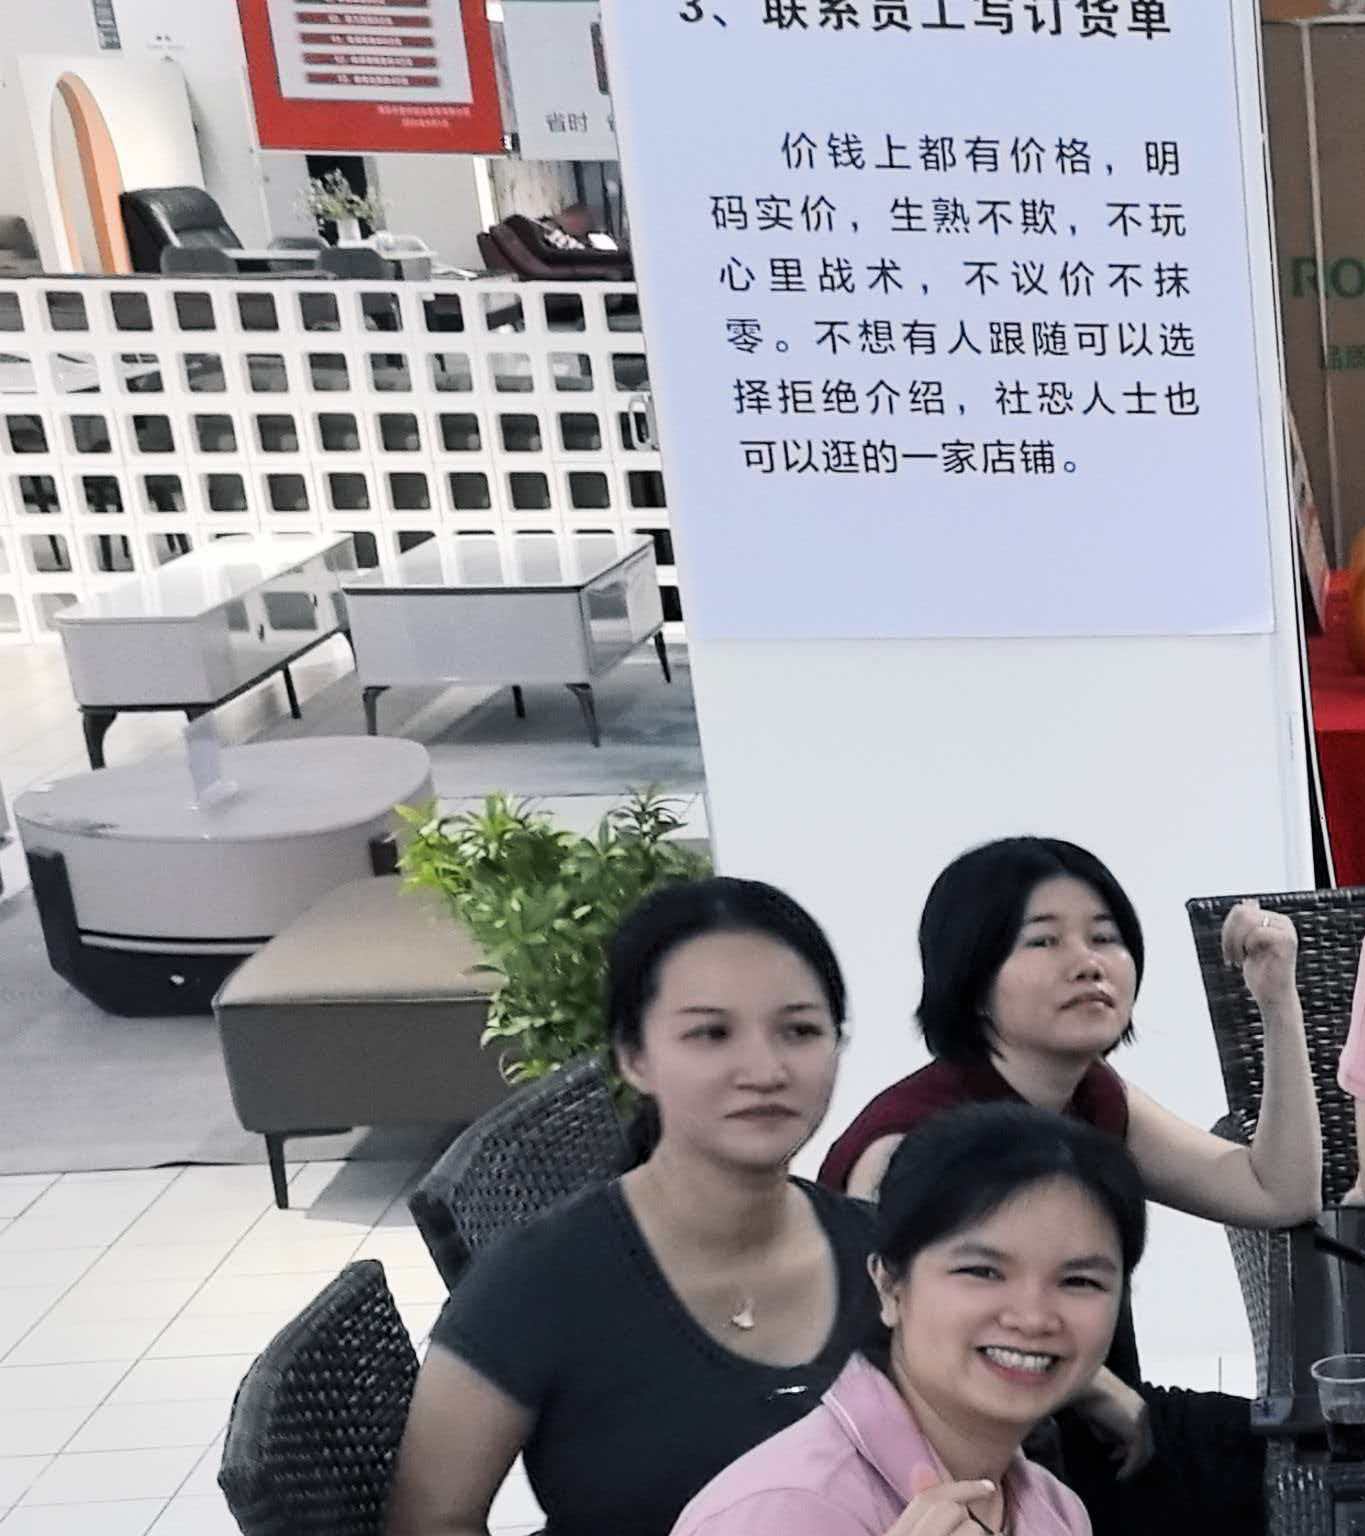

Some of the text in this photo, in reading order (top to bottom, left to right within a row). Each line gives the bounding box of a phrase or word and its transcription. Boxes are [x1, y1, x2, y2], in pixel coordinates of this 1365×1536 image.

[781, 132, 1181, 176] 价钱上都有价格，明
[710, 193, 1187, 238] 码实价，生熟不欺，不玩
[719, 256, 1191, 298] 心里战术，不议价不抹
[725, 317, 1197, 358] 零。不想有人跟随可以选
[733, 378, 1201, 417] 择拒绝介绍，社恐人士也
[739, 439, 1078, 476] 可以逛的一家店铺。
